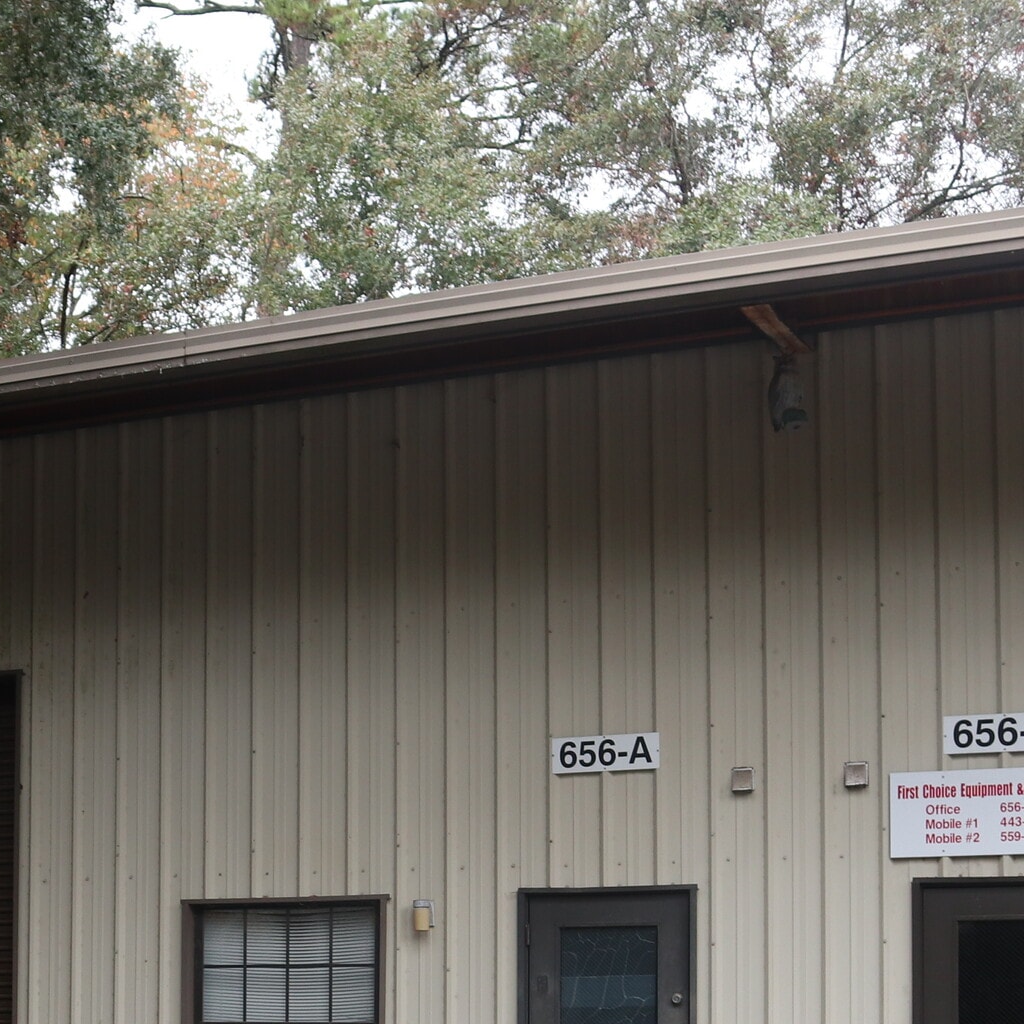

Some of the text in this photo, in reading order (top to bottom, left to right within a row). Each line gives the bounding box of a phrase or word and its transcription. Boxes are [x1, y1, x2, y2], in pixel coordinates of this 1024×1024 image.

[559, 736, 653, 768] 656-A
[897, 782, 1024, 799] First Choice Equipment &
[925, 804, 961, 815] Office
[925, 818, 962, 830] Mobile
[965, 818, 979, 829] #1
[925, 833, 962, 844] Mobile
[965, 833, 980, 843] #2
